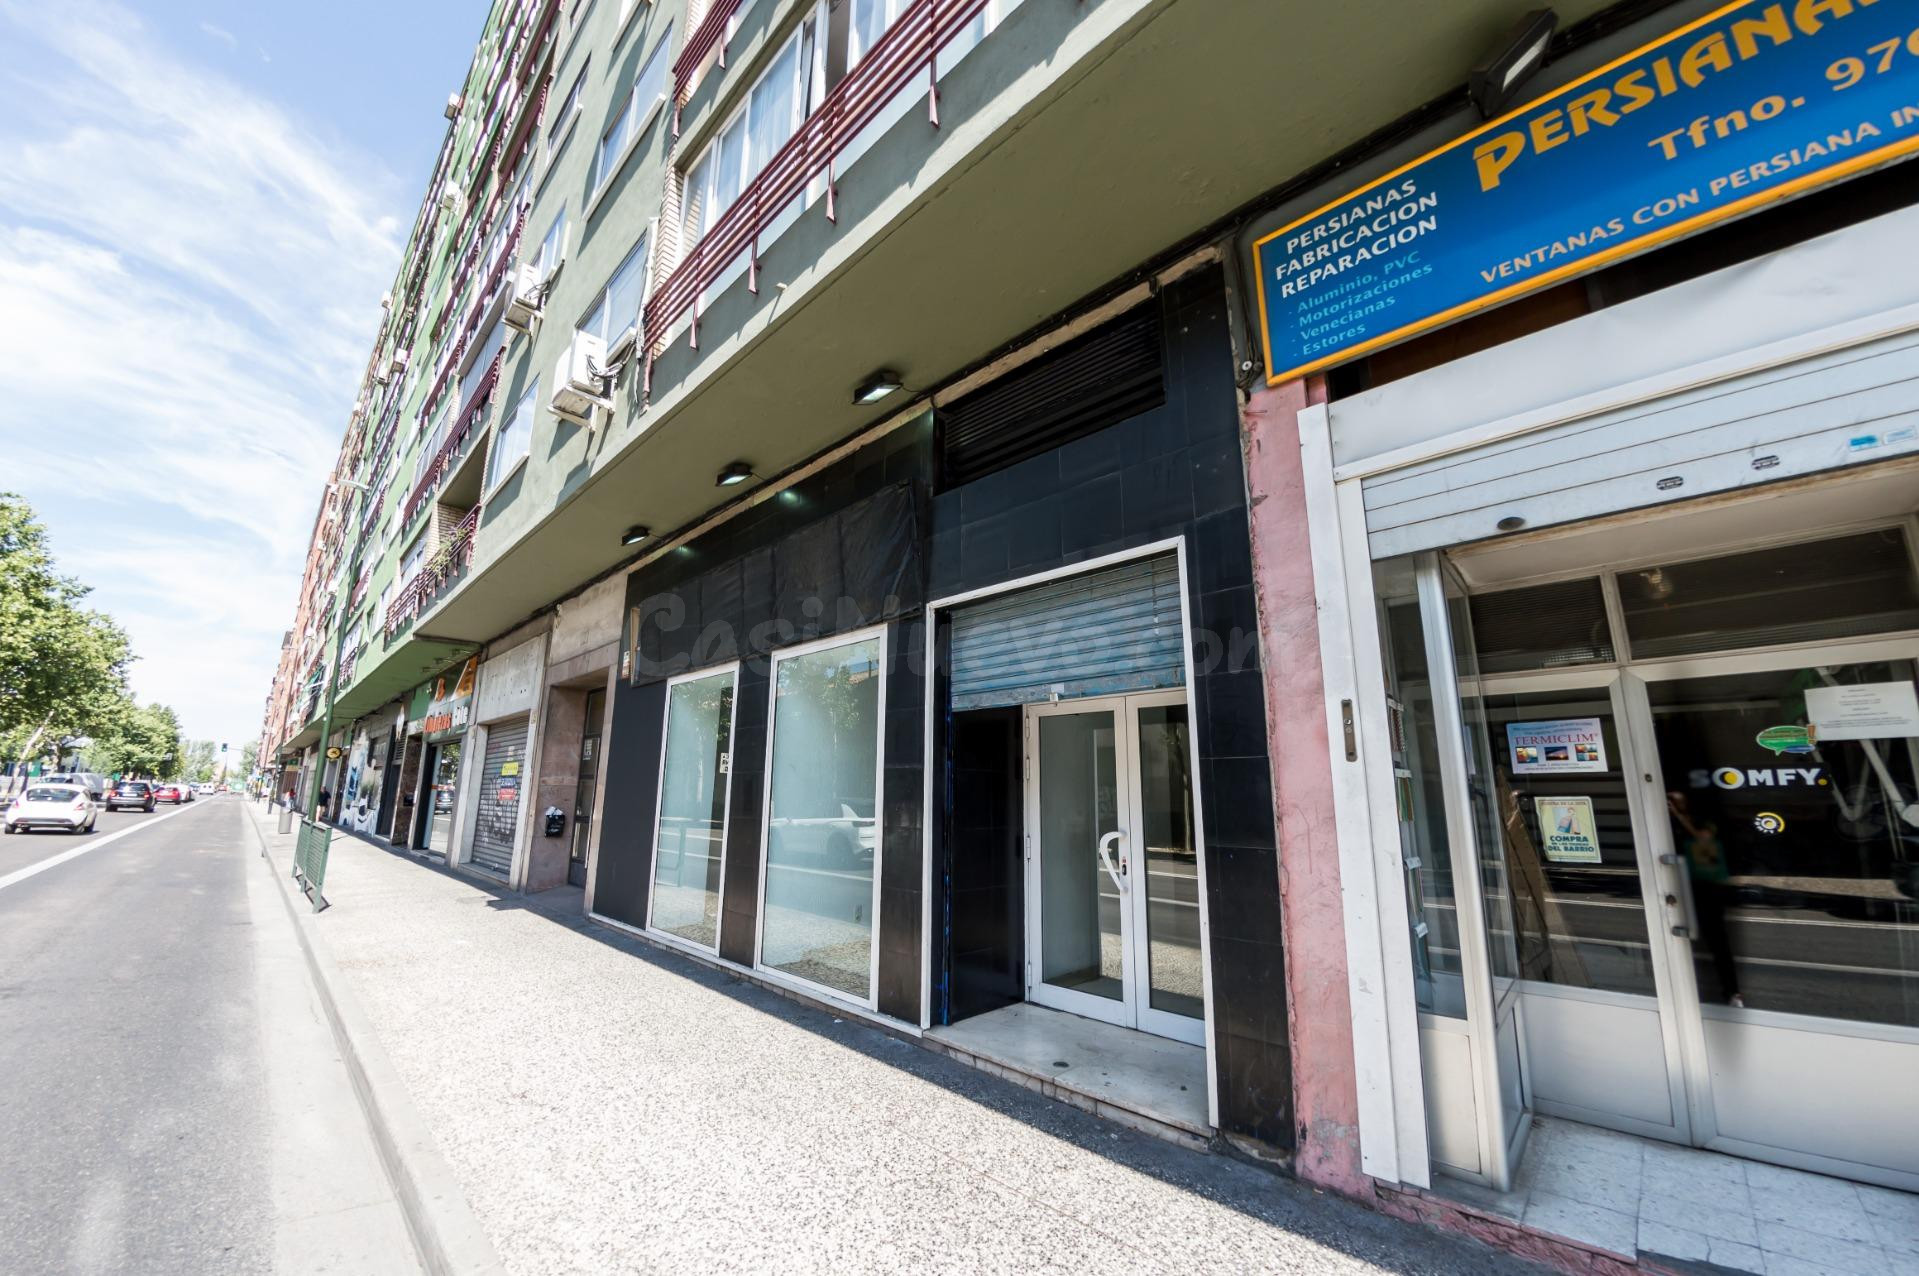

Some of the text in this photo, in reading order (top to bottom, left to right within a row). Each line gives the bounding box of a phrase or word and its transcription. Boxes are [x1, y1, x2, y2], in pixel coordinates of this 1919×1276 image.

[1473, 0, 1881, 192] PERSIANA
[1648, 96, 1805, 160] Tfno.
[1276, 192, 1437, 280] FABRICACION
[1286, 179, 1416, 254] PERSIANAS
[1480, 218, 1624, 283] VENTANAS
[1632, 188, 1699, 225] CON
[1709, 122, 1882, 196] PERSIANA
[1281, 215, 1437, 298] REPARACION
[1297, 251, 1421, 313] Aluminio, PVC
[1299, 263, 1433, 327] Motorizaciones
[1301, 296, 1396, 341] Venecianas
[1303, 324, 1366, 356] Estores
